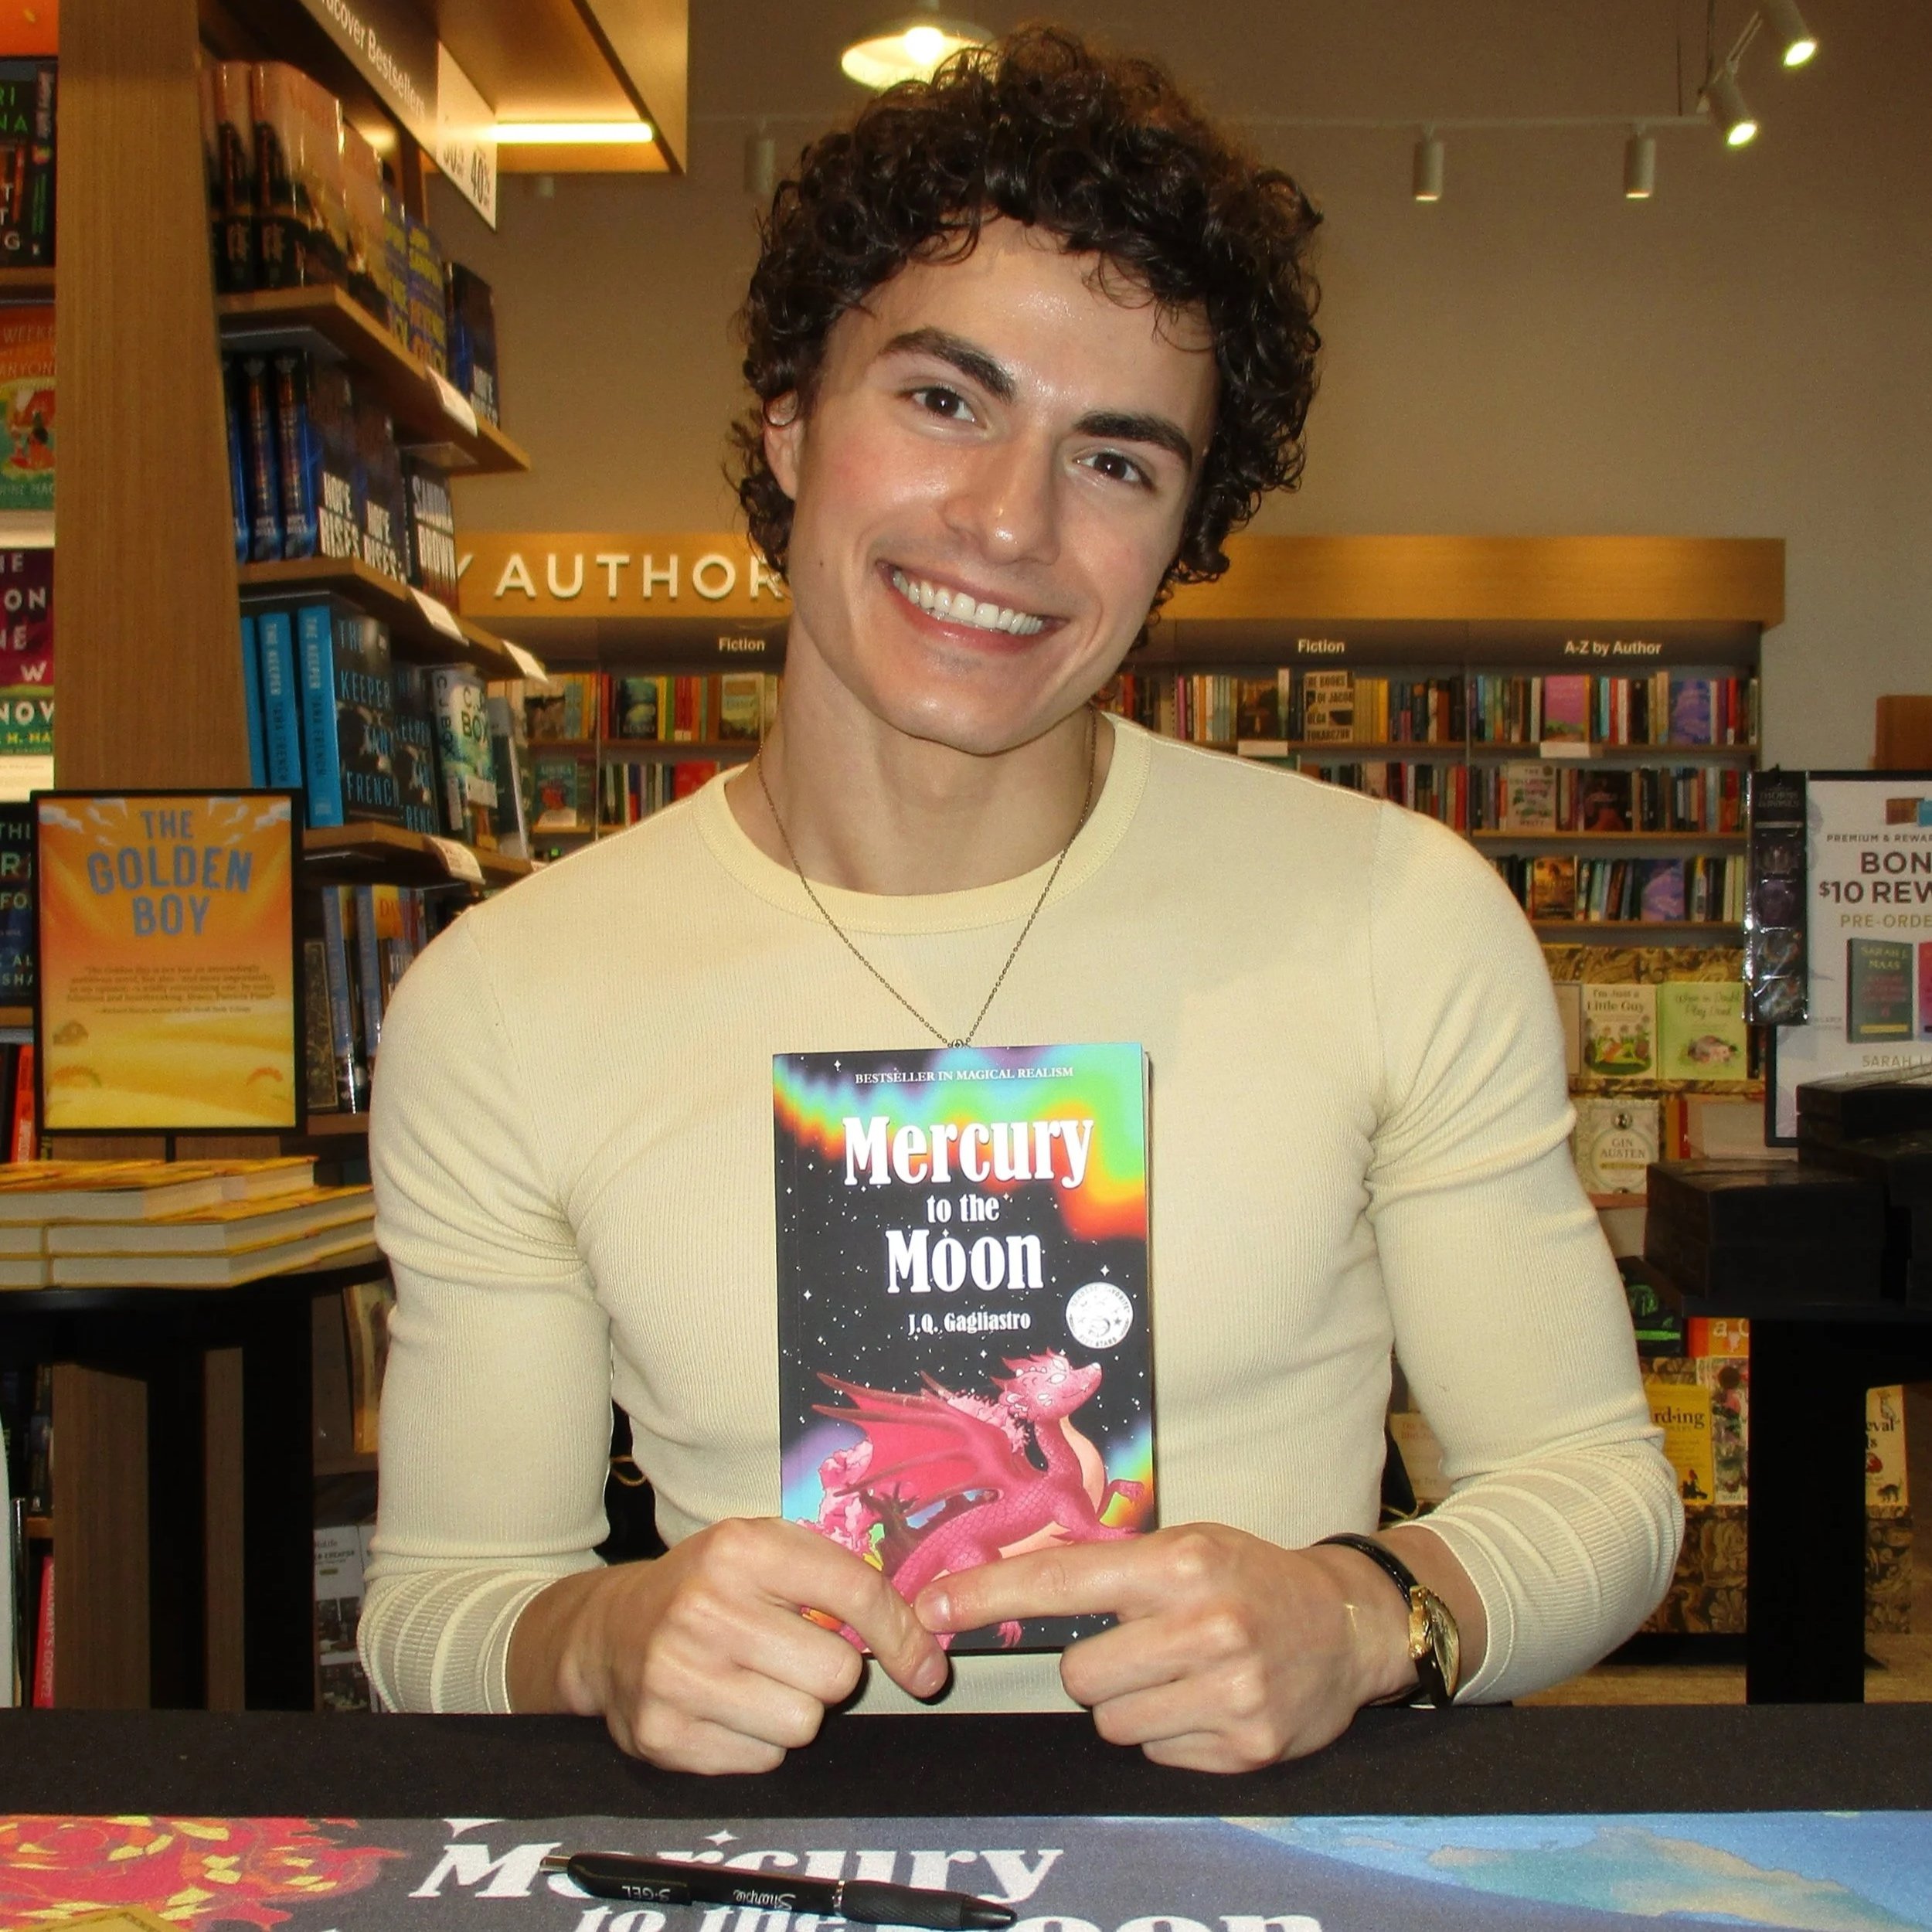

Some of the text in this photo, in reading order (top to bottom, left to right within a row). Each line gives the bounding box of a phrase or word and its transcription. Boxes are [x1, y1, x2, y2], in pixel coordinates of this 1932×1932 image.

[322, 0, 366, 49] dcover
[368, 29, 425, 117] Bestsellers
[718, 637, 766, 653] Fiction
[1298, 638, 1345, 654] Fiction
[1564, 640, 1662, 658] A-Z by Author
[140, 810, 194, 840] THE
[1827, 834, 1878, 843] PREMIUM
[1883, 834, 1889, 843] &
[86, 846, 253, 896] GOLDEN
[1861, 852, 1932, 874] BON
[1819, 881, 1864, 904] $10
[132, 895, 211, 936] BOY
[1587, 1000, 1645, 1013] Little Guy
[1862, 1055, 1912, 1068] SARAH
[855, 1066, 1074, 1084] BESTSELLER IN MAGICAL REALISM
[842, 1116, 1094, 1189] Mercury
[1600, 1148, 1645, 1158] AUSTEN
[1611, 1138, 1633, 1147] GIN
[927, 1193, 1001, 1223] to the
[884, 1228, 1045, 1294] Moon
[907, 1310, 1032, 1335] J.Q. Gagliastro
[409, 1842, 1063, 1904] Mury
[733, 1889, 797, 1911] Sharpie
